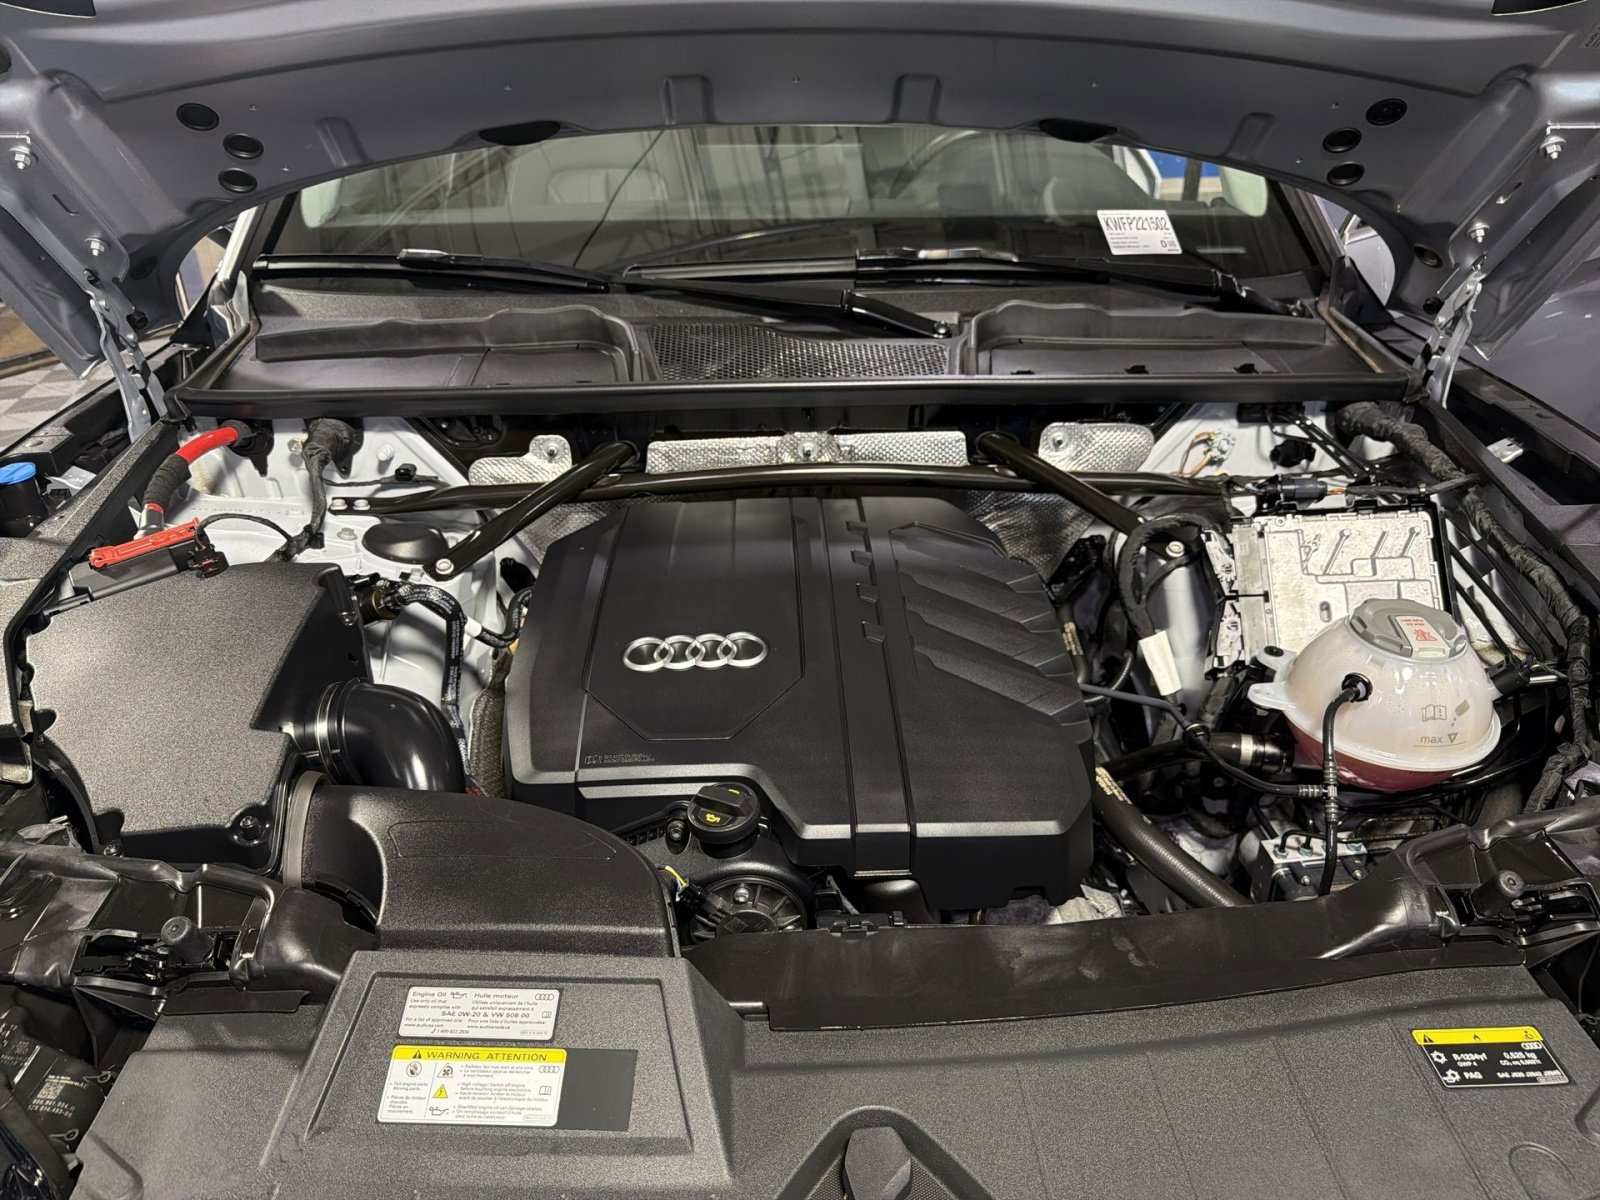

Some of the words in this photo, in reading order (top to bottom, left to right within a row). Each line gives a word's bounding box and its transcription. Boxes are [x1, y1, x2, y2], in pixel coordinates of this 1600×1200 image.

[1103, 217, 1170, 231] KWFP221502
[1420, 736, 1443, 744] max
[427, 1051, 480, 1060] WARNING
[486, 1053, 547, 1061] ATTENTION
[1452, 1052, 1488, 1061] R-1234yf
[1463, 1071, 1483, 1079] PAG
